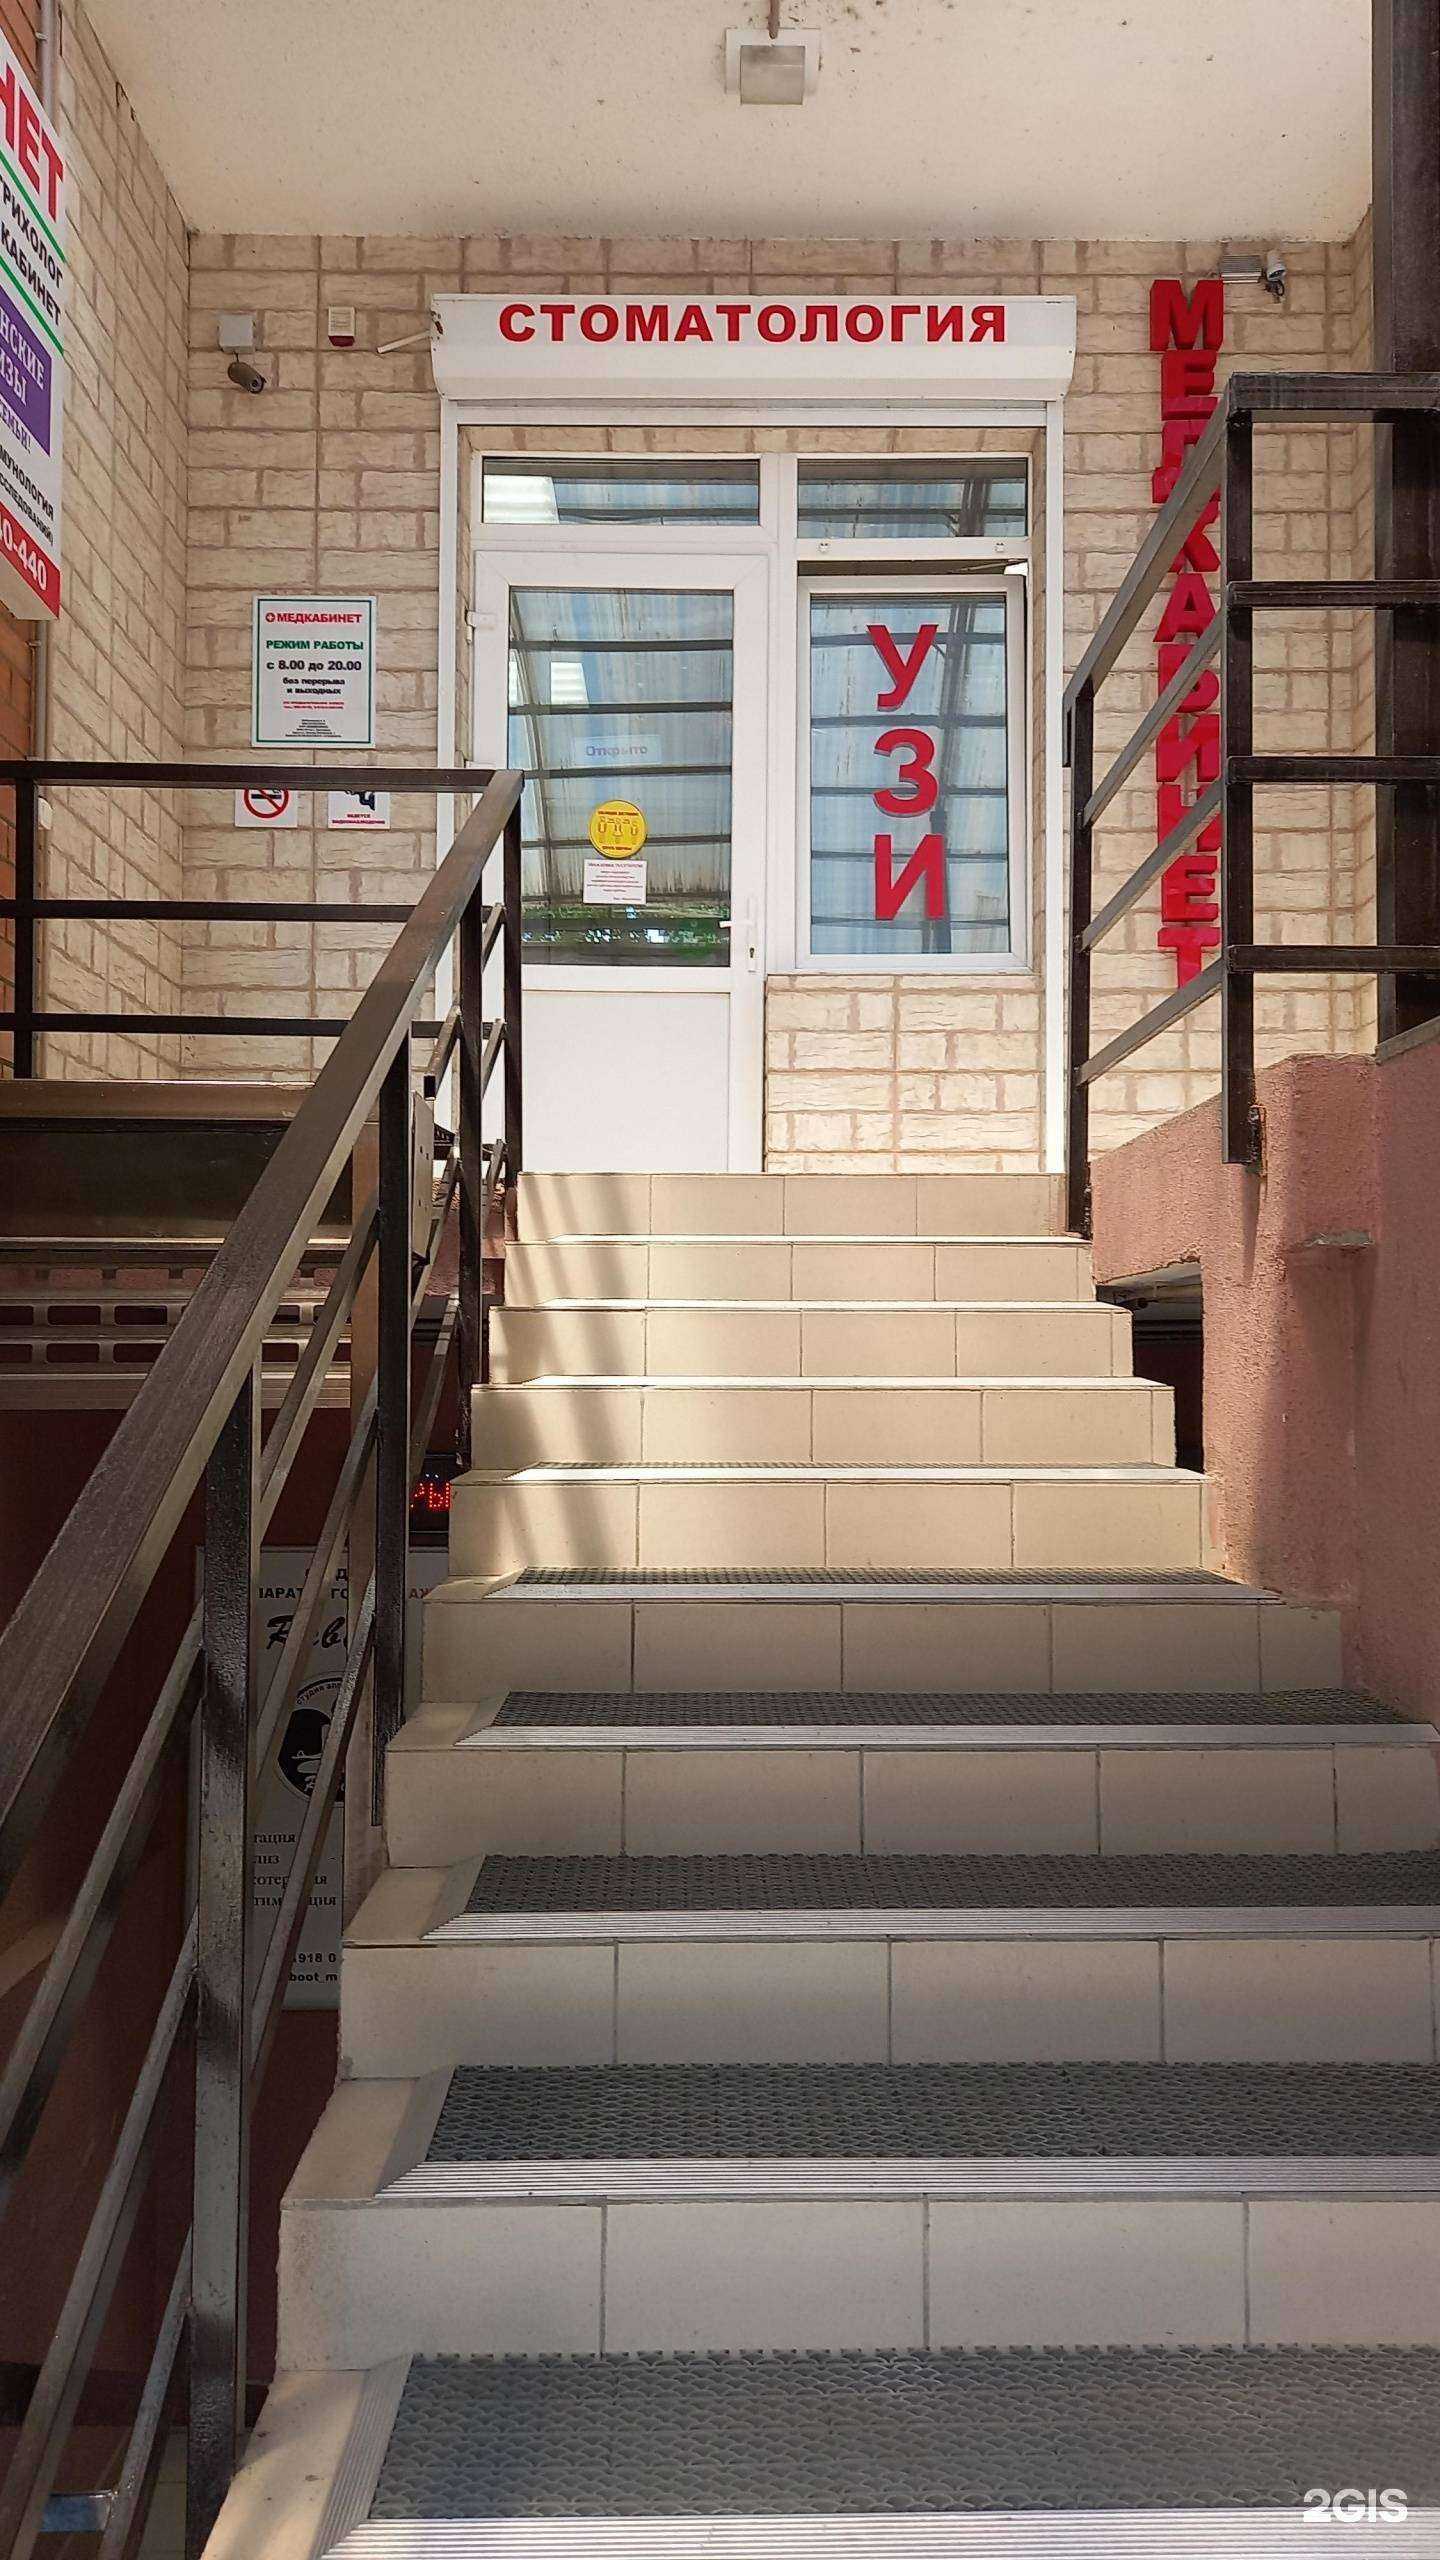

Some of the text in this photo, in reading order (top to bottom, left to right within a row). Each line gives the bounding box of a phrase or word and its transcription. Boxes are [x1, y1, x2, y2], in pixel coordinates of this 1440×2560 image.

[1, 221, 61, 326] КАБИНЕТ
[499, 304, 1006, 343] СТОМАТОЛОГИЯ
[277, 613, 362, 624] МЕДКАБИНЕТ
[266, 641, 364, 650] РЕЖИМ РАБОТЫ
[278, 660, 305, 670] 8.00
[308, 662, 324, 672] до
[328, 661, 362, 671] 20.00
[867, 624, 947, 920] УЗИ
